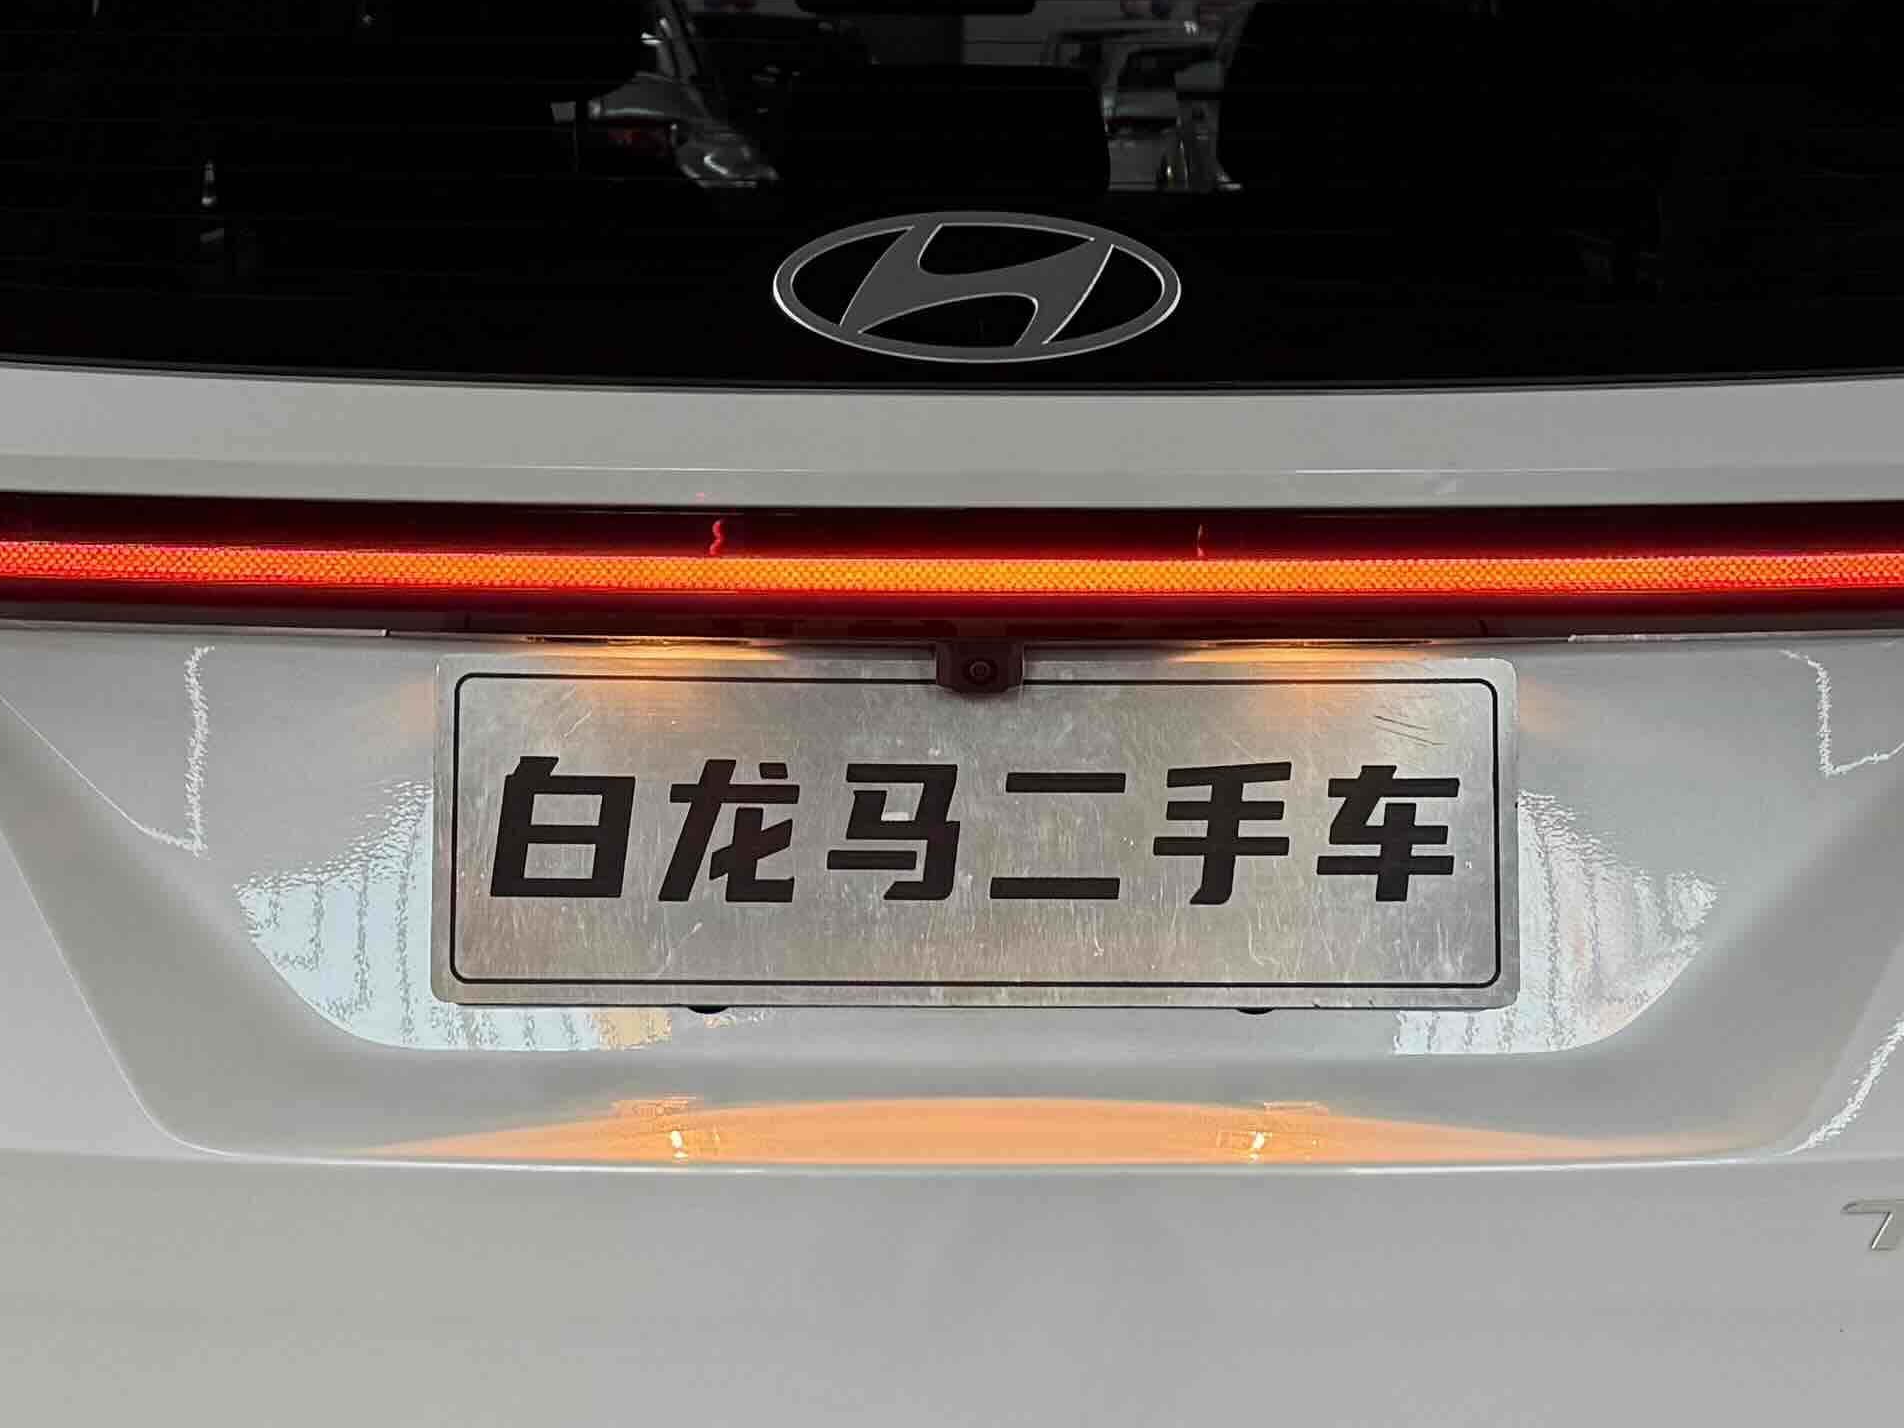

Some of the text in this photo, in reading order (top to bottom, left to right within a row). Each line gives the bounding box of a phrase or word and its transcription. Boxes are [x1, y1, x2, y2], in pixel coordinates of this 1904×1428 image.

[490, 755, 1461, 905] 白龙马二手车
